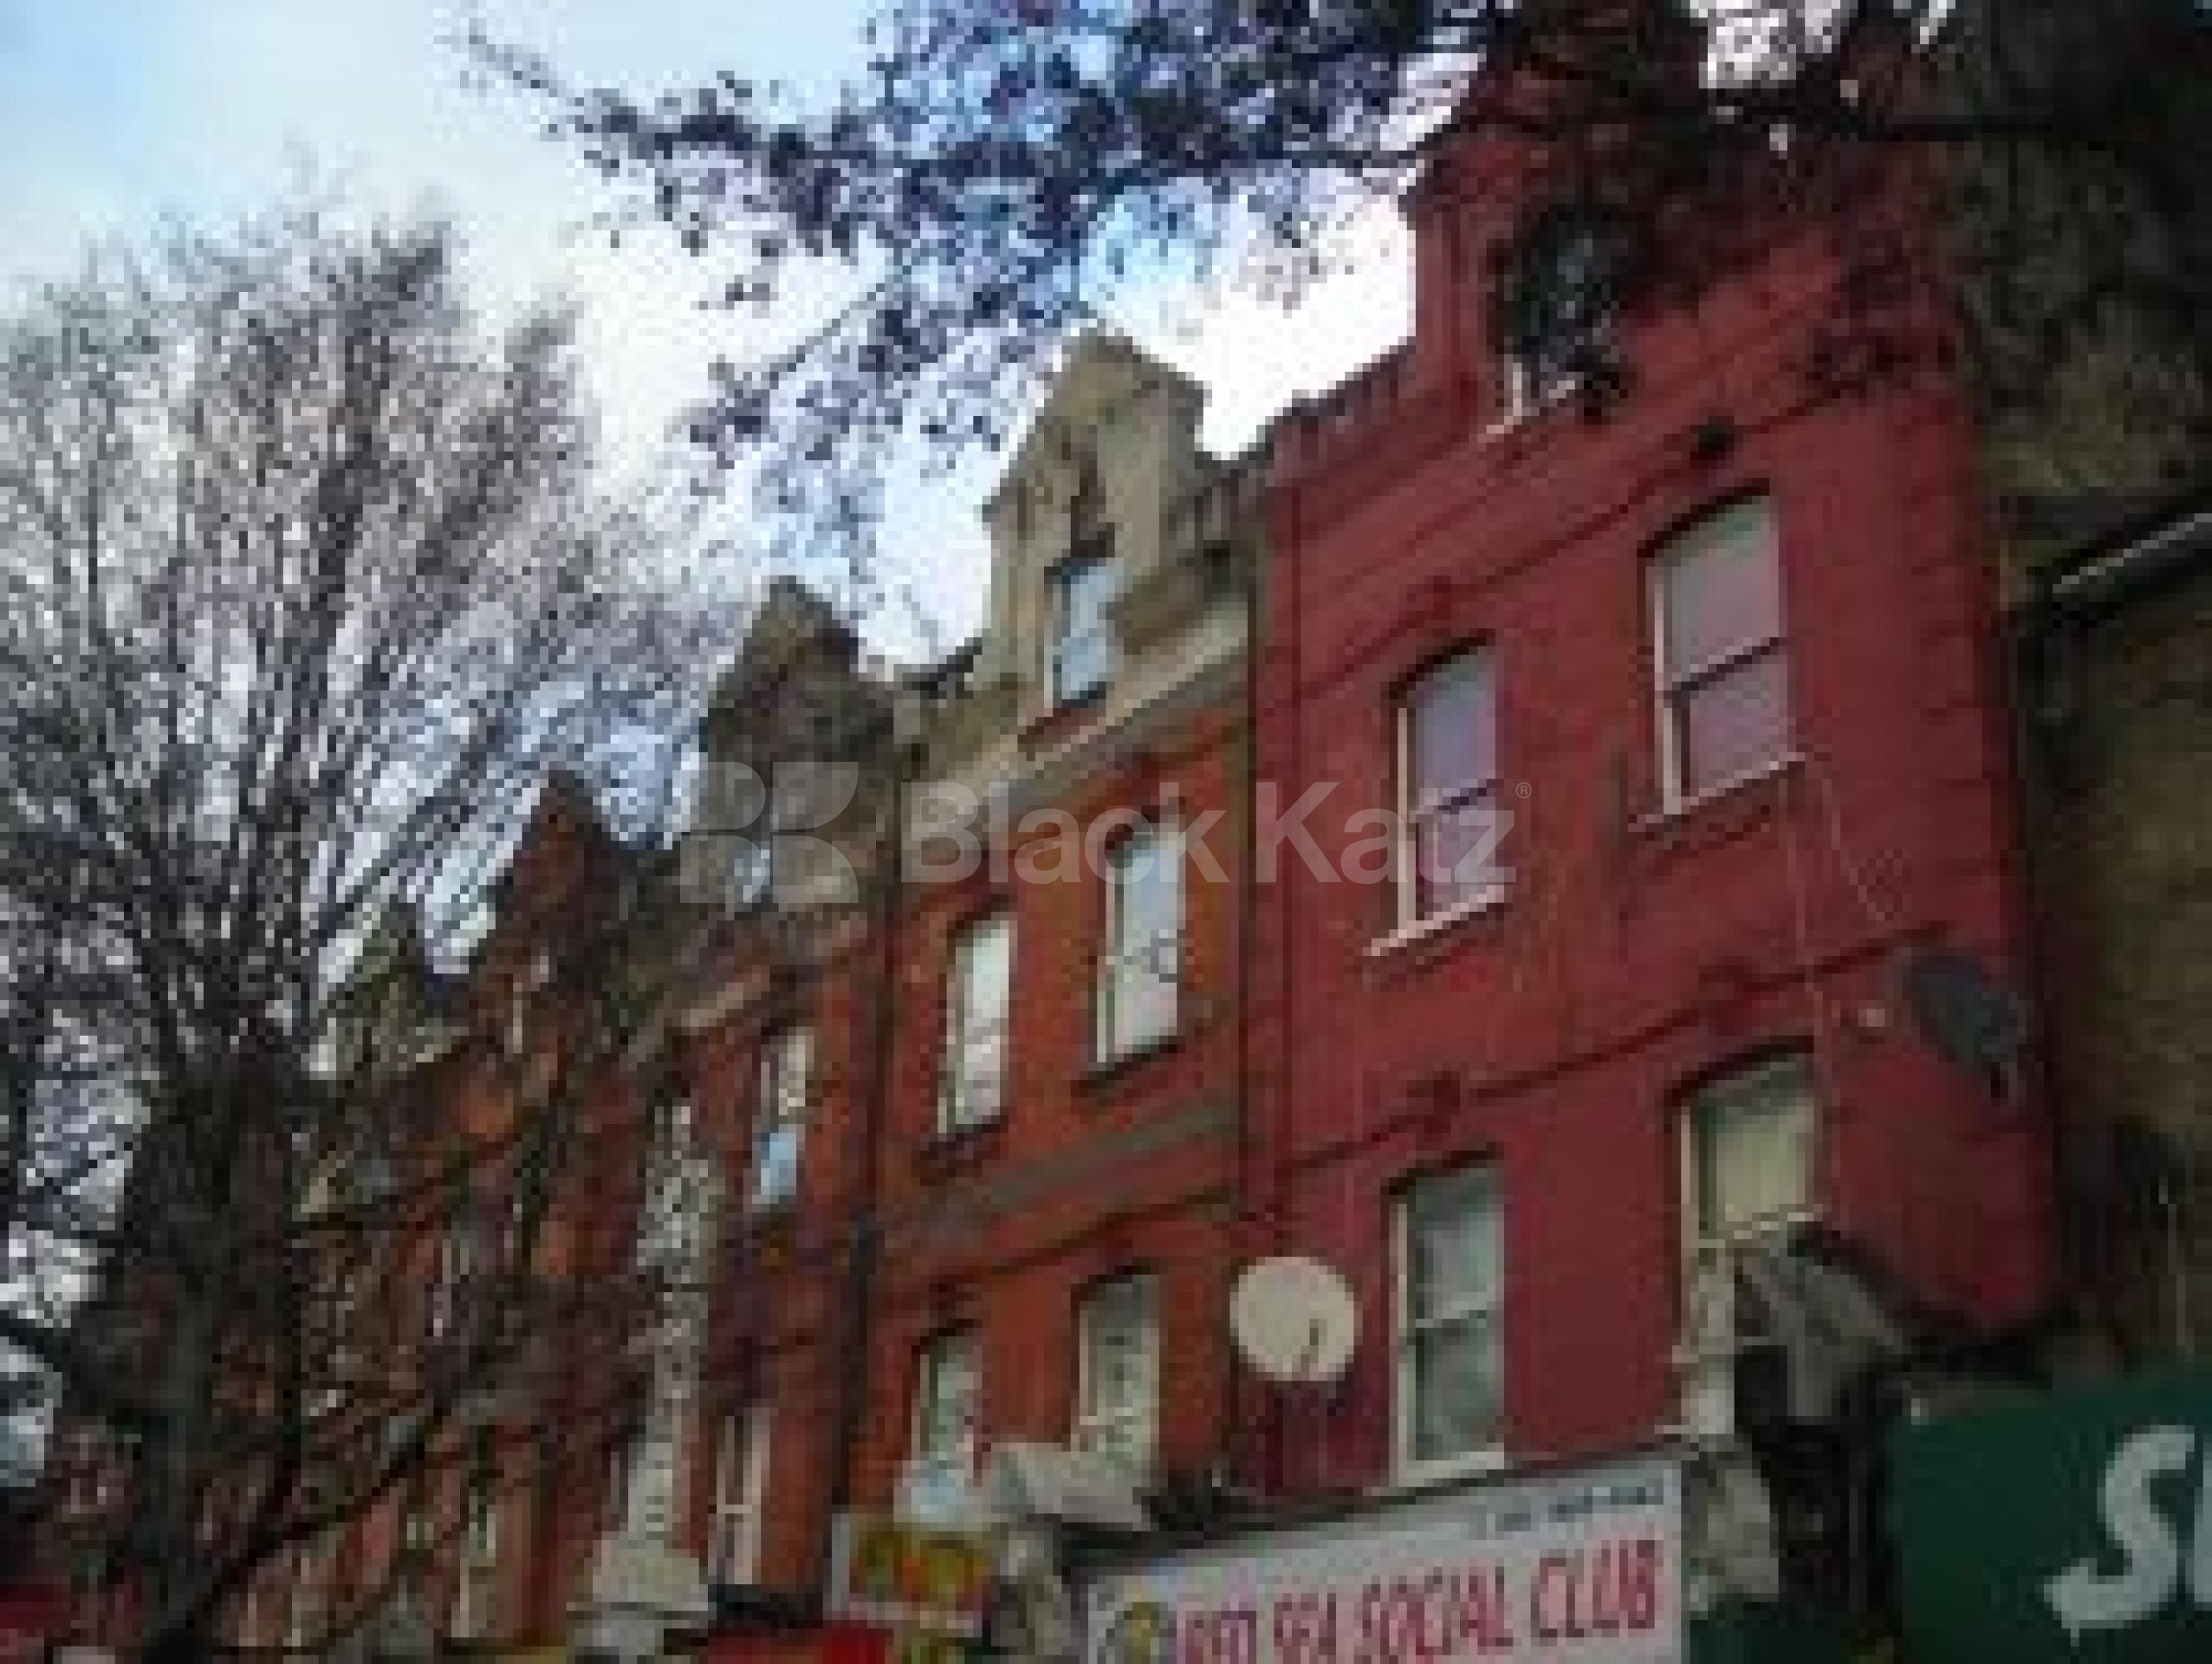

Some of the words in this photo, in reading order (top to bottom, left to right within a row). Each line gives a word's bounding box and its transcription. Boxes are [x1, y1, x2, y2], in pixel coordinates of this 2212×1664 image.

[1355, 1563, 1515, 1664] SOCIAL
[1529, 1538, 1656, 1640] CLUB
[2045, 1423, 2212, 1647] S
